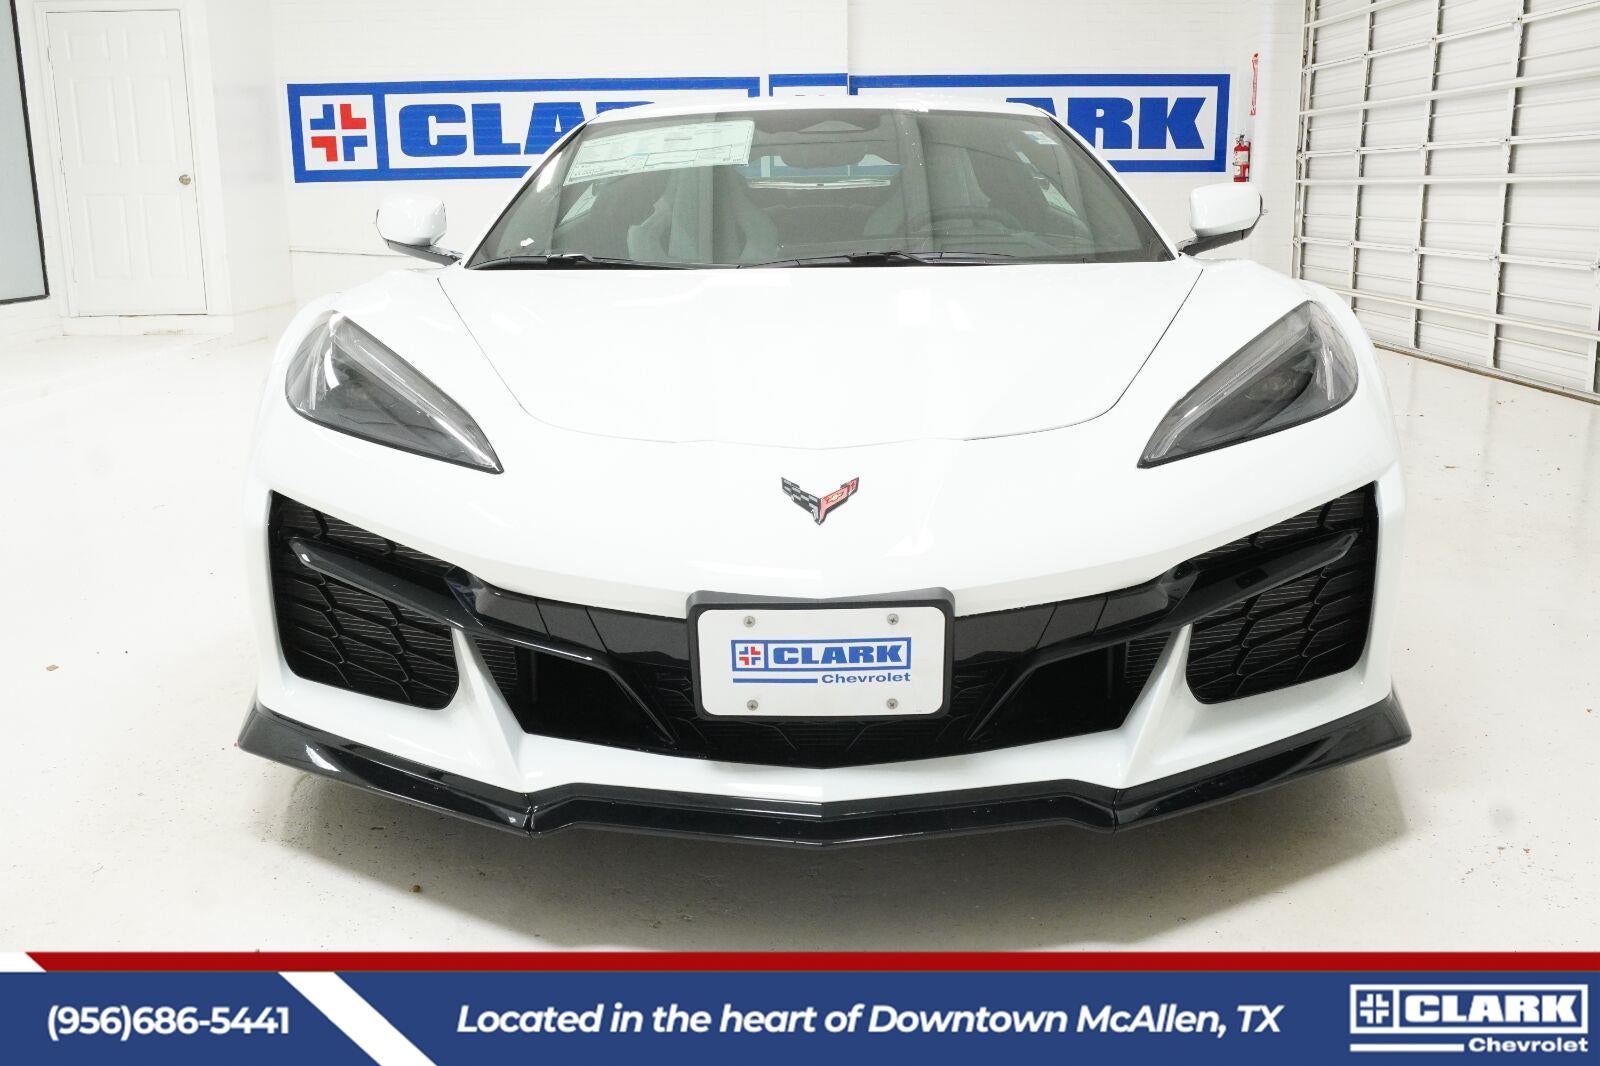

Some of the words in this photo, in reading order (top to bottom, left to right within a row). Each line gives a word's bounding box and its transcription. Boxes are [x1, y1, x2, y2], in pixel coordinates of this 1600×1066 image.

[399, 101, 656, 157] CLA
[1006, 97, 1207, 149] RK
[773, 645, 903, 665] CLARK
[821, 672, 911, 684] Chevrolet
